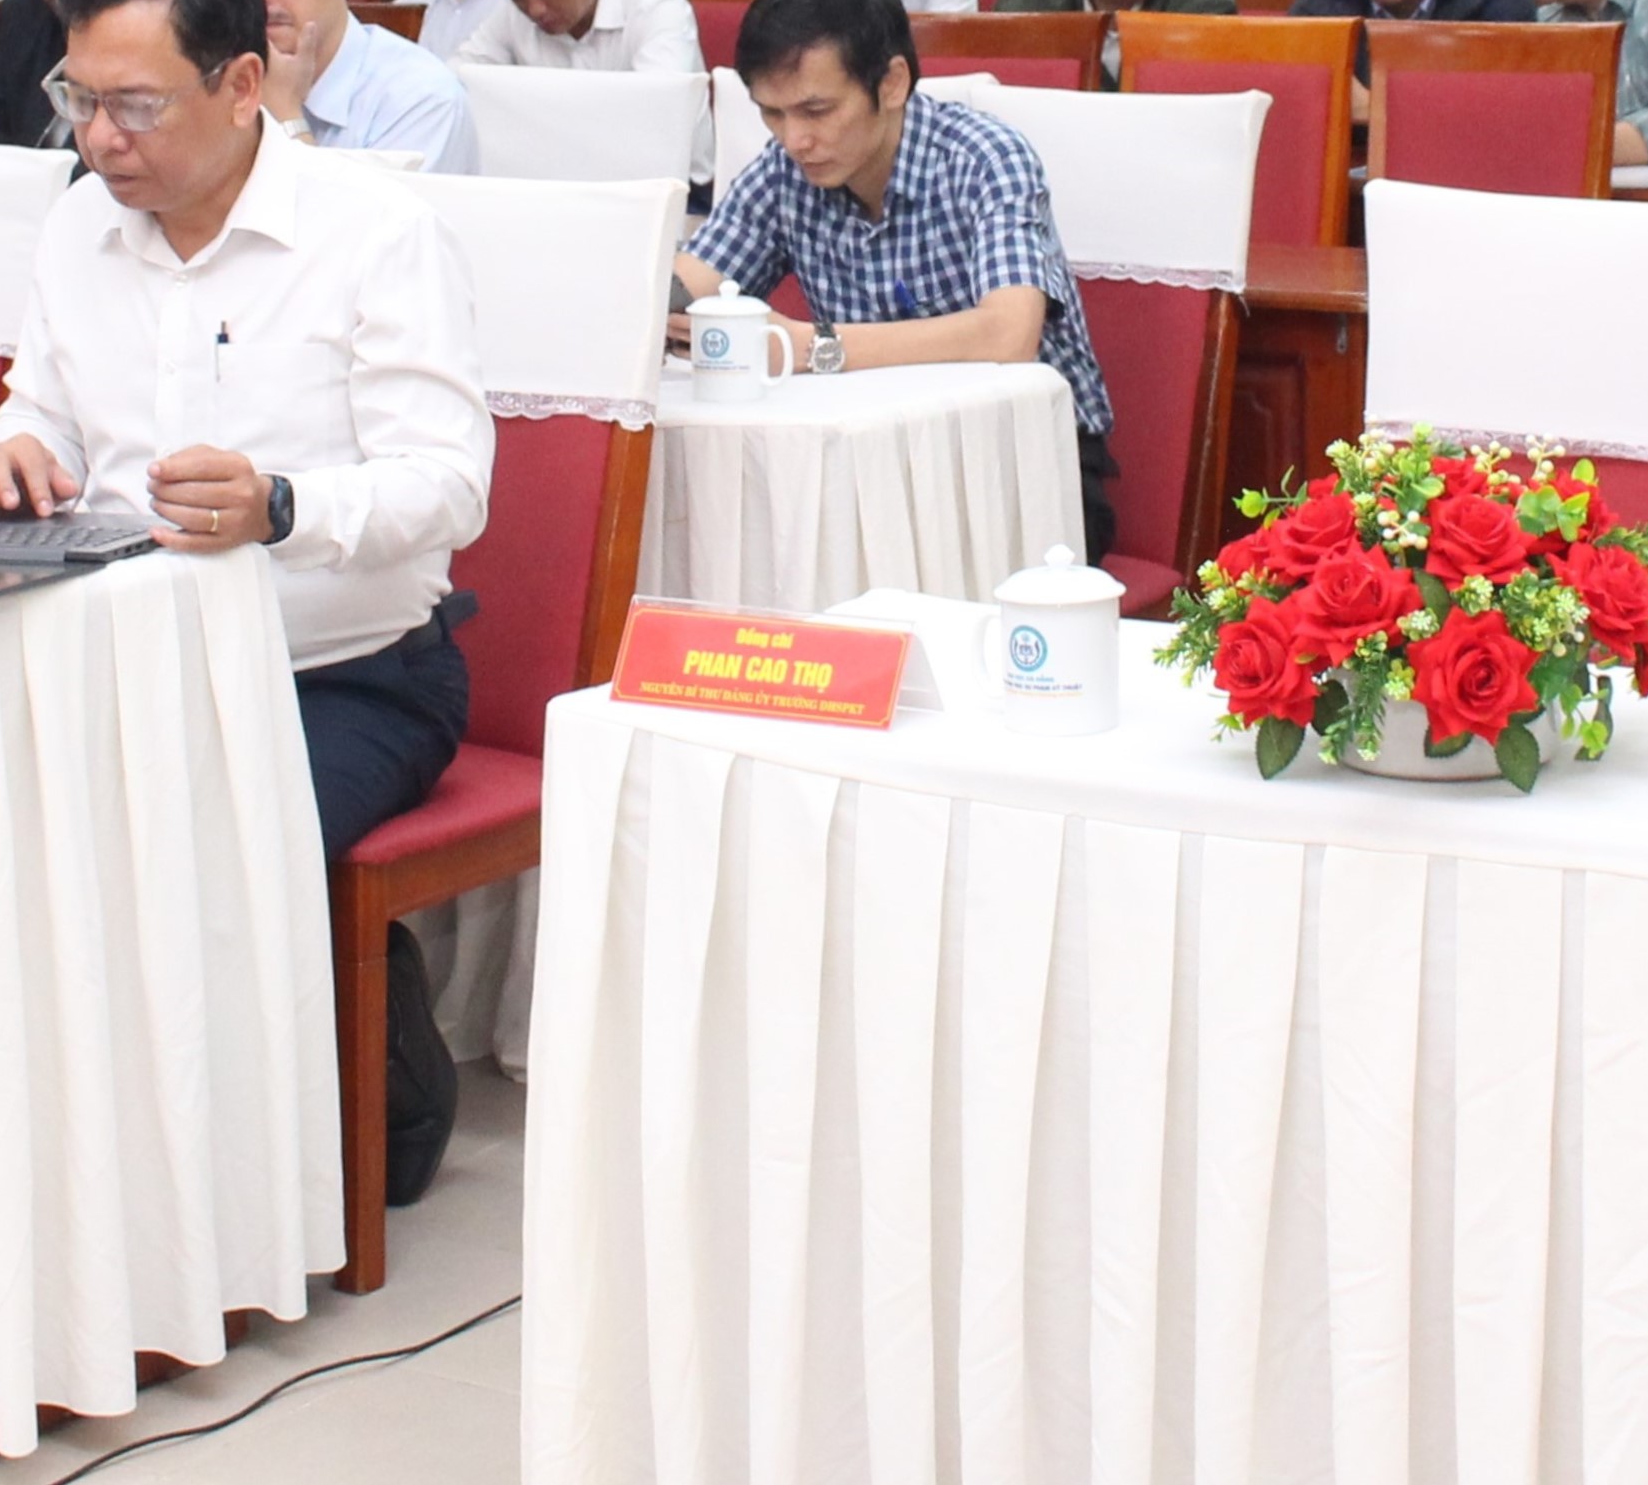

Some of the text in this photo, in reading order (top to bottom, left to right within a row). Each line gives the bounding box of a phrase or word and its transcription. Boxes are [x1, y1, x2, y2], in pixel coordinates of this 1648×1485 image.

[736, 627, 794, 649] Đồng chí
[683, 650, 834, 693] PHAN CAO THỌ
